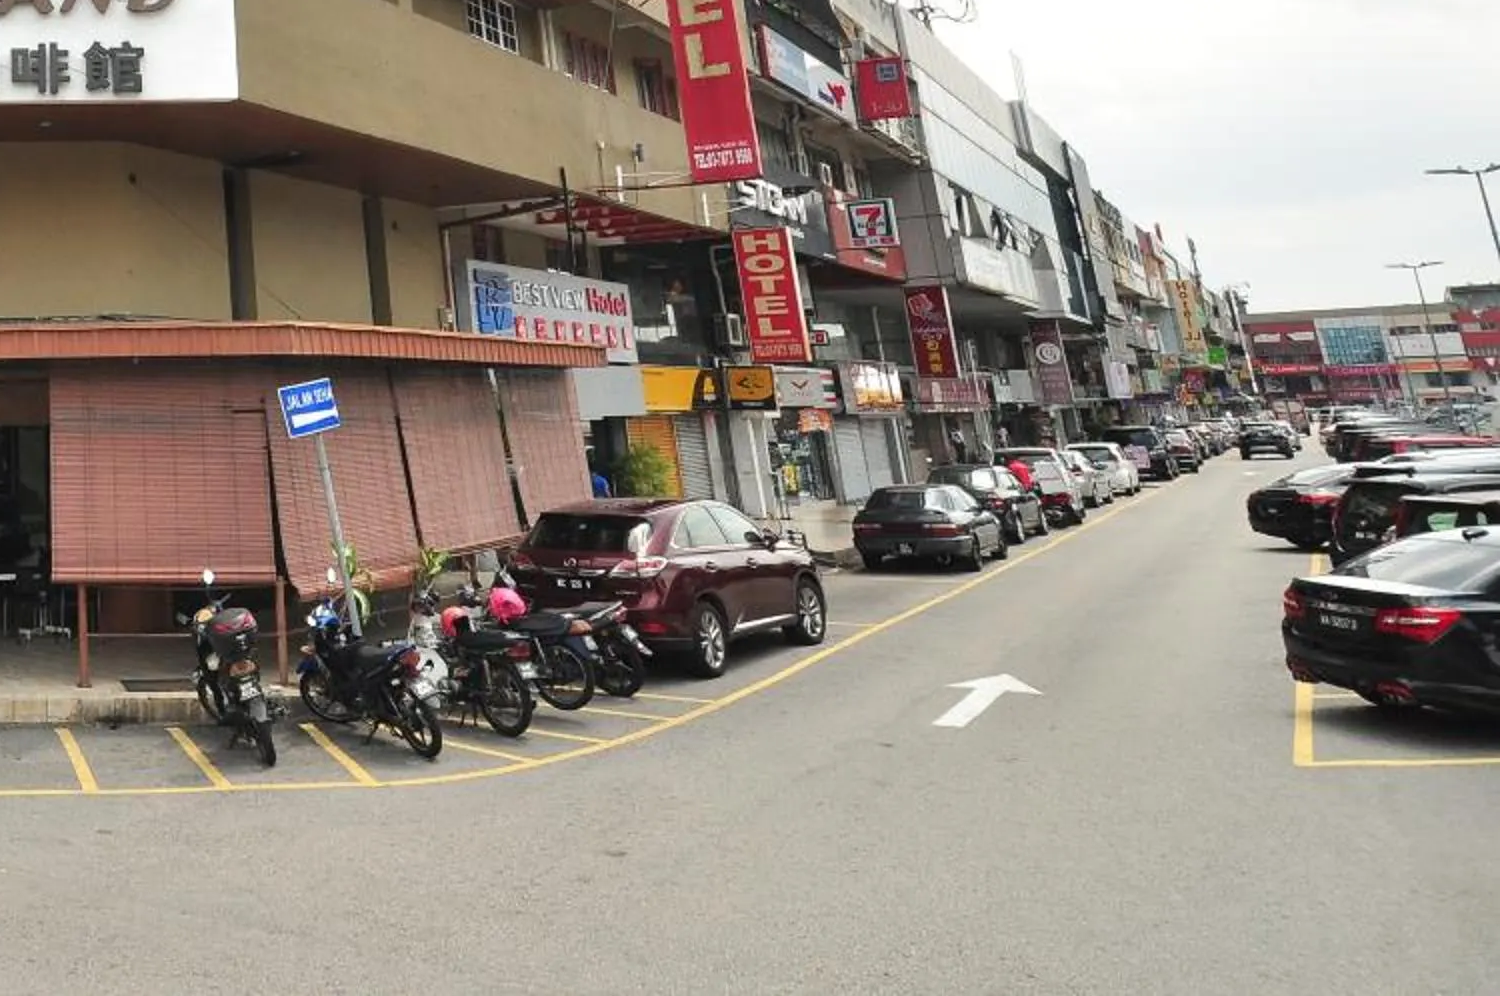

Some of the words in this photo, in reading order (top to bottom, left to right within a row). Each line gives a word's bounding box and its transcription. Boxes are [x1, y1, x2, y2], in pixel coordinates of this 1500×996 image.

[512, 281, 549, 308] BEST
[549, 285, 583, 312] VIEW
[585, 287, 627, 316] Hotel
[741, 232, 792, 337] HOTEL
